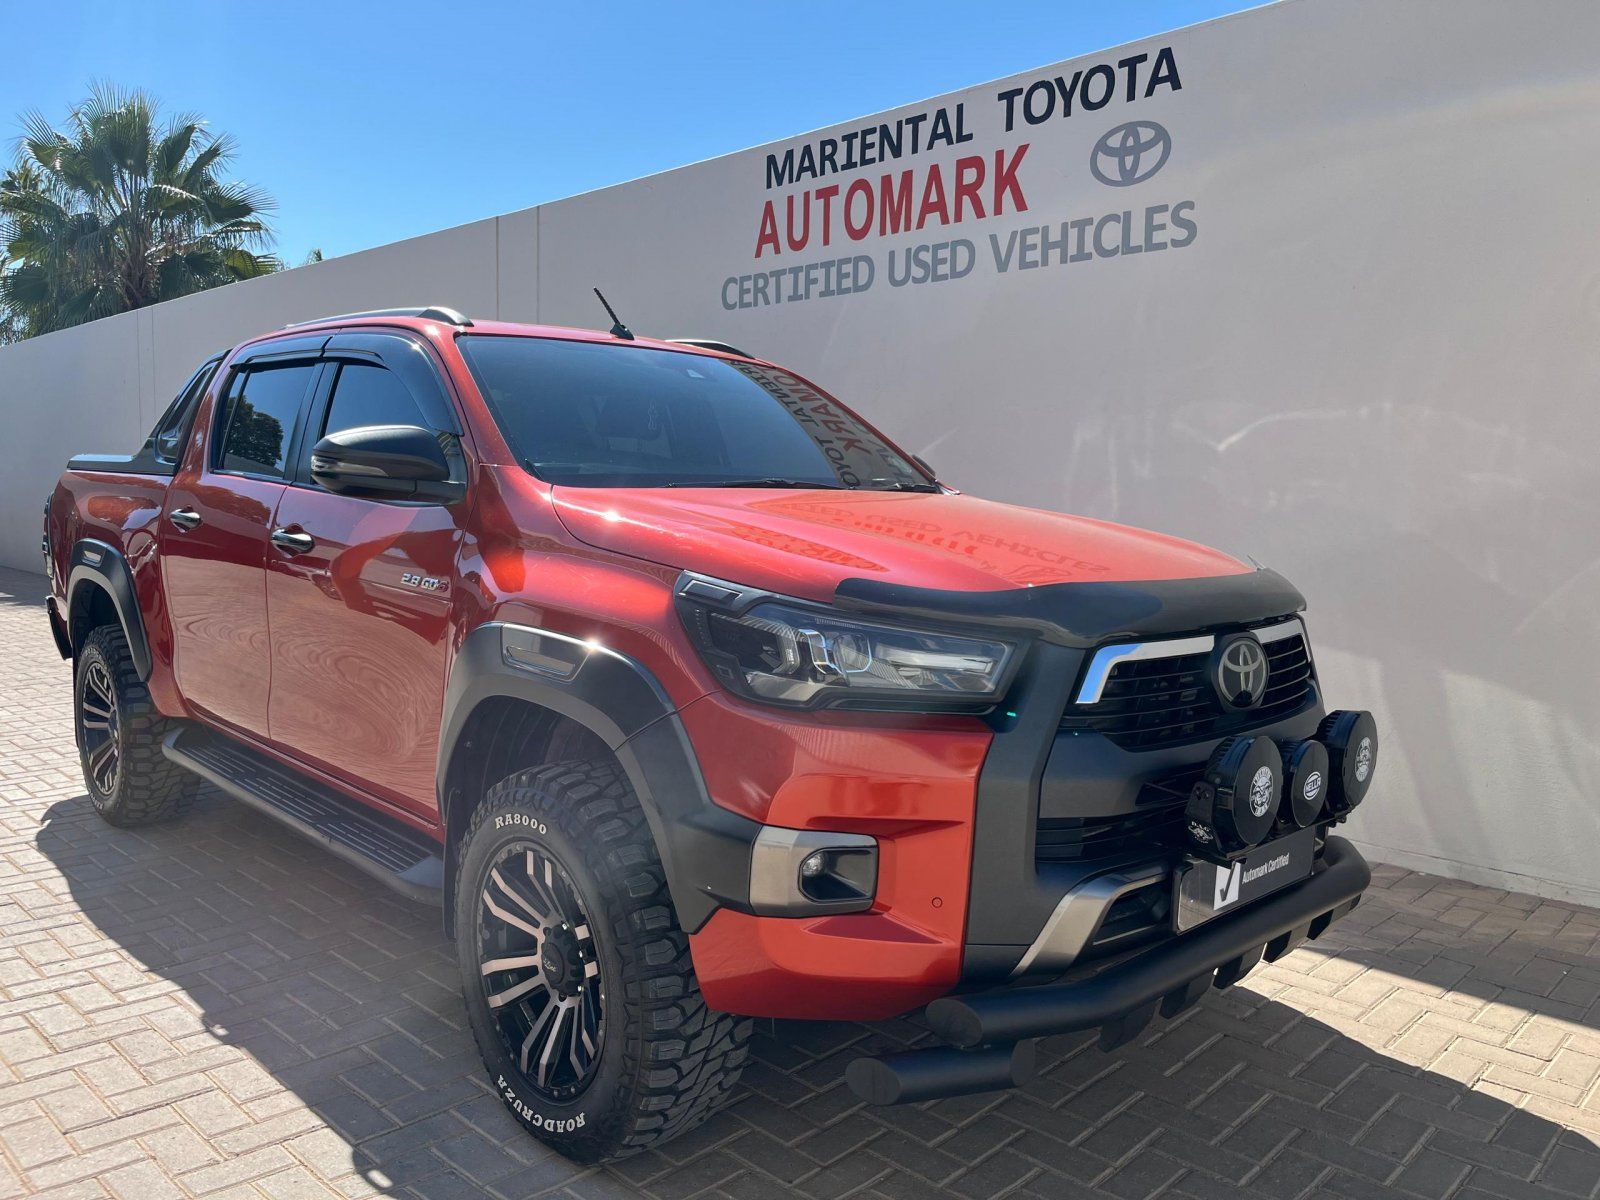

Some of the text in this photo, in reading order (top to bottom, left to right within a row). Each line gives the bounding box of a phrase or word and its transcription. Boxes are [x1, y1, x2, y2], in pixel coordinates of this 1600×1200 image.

[765, 46, 1182, 189] MARIENTAL TOYOTA
[754, 143, 1030, 259] AUTOMARK
[721, 200, 1197, 310] CERTIFIED USED VEHICLES
[494, 813, 548, 835] RA8000
[1242, 852, 1290, 885] Automark Certified
[498, 1073, 587, 1133] ROADCRUZA
